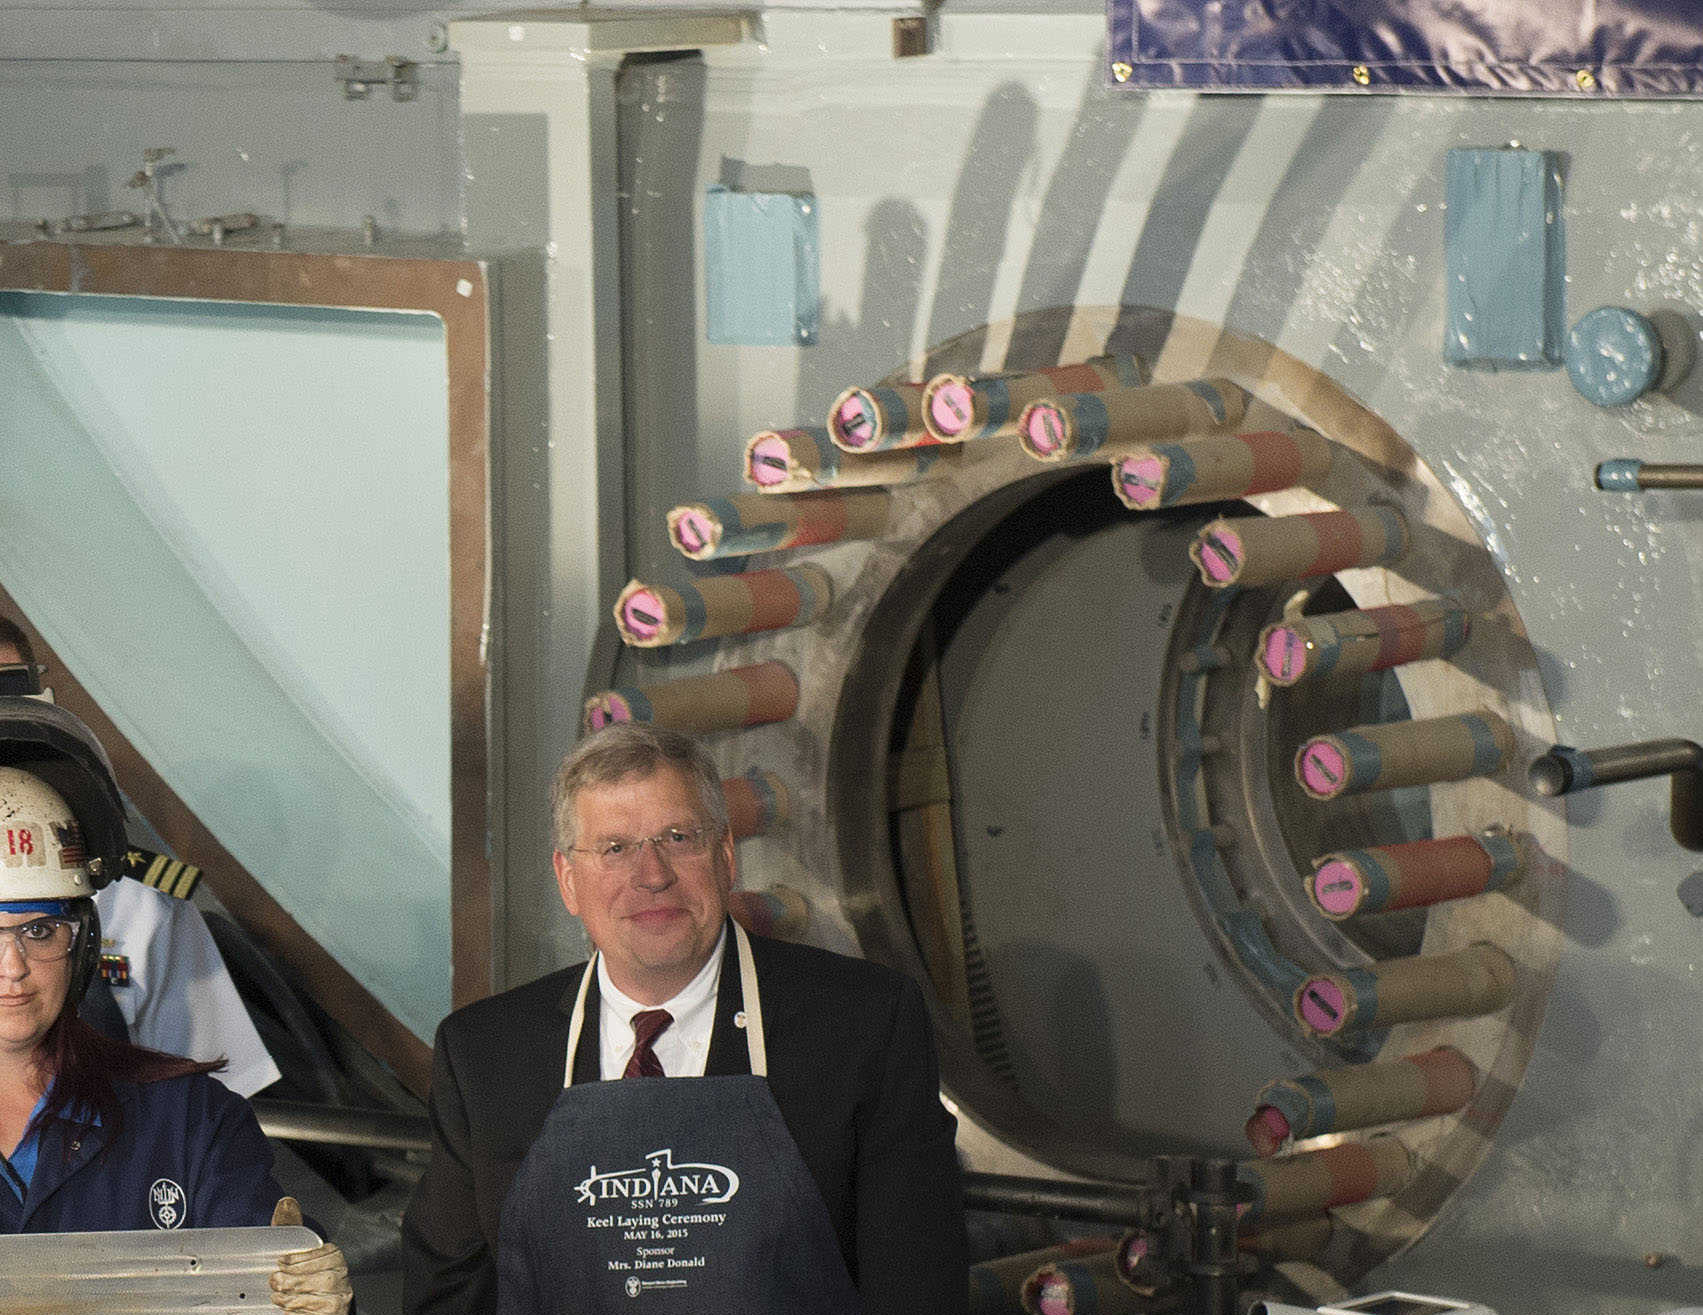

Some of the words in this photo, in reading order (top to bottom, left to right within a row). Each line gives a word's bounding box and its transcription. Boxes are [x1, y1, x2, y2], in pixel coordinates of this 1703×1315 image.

[6, 828, 34, 856] 18
[599, 1168, 720, 1200] INDIANA
[631, 1199, 654, 1209] SSN
[658, 1198, 679, 1208] 789
[586, 1215, 614, 1228] Keel
[617, 1214, 659, 1229] Laying
[662, 1213, 727, 1226] Ceremony
[624, 1230, 648, 1241] MAY
[666, 1228, 689, 1238] 2015
[636, 1247, 675, 1259] Sponsor
[607, 1261, 631, 1271] Mrs.
[634, 1259, 665, 1270] Diane
[667, 1256, 706, 1268] Donald
